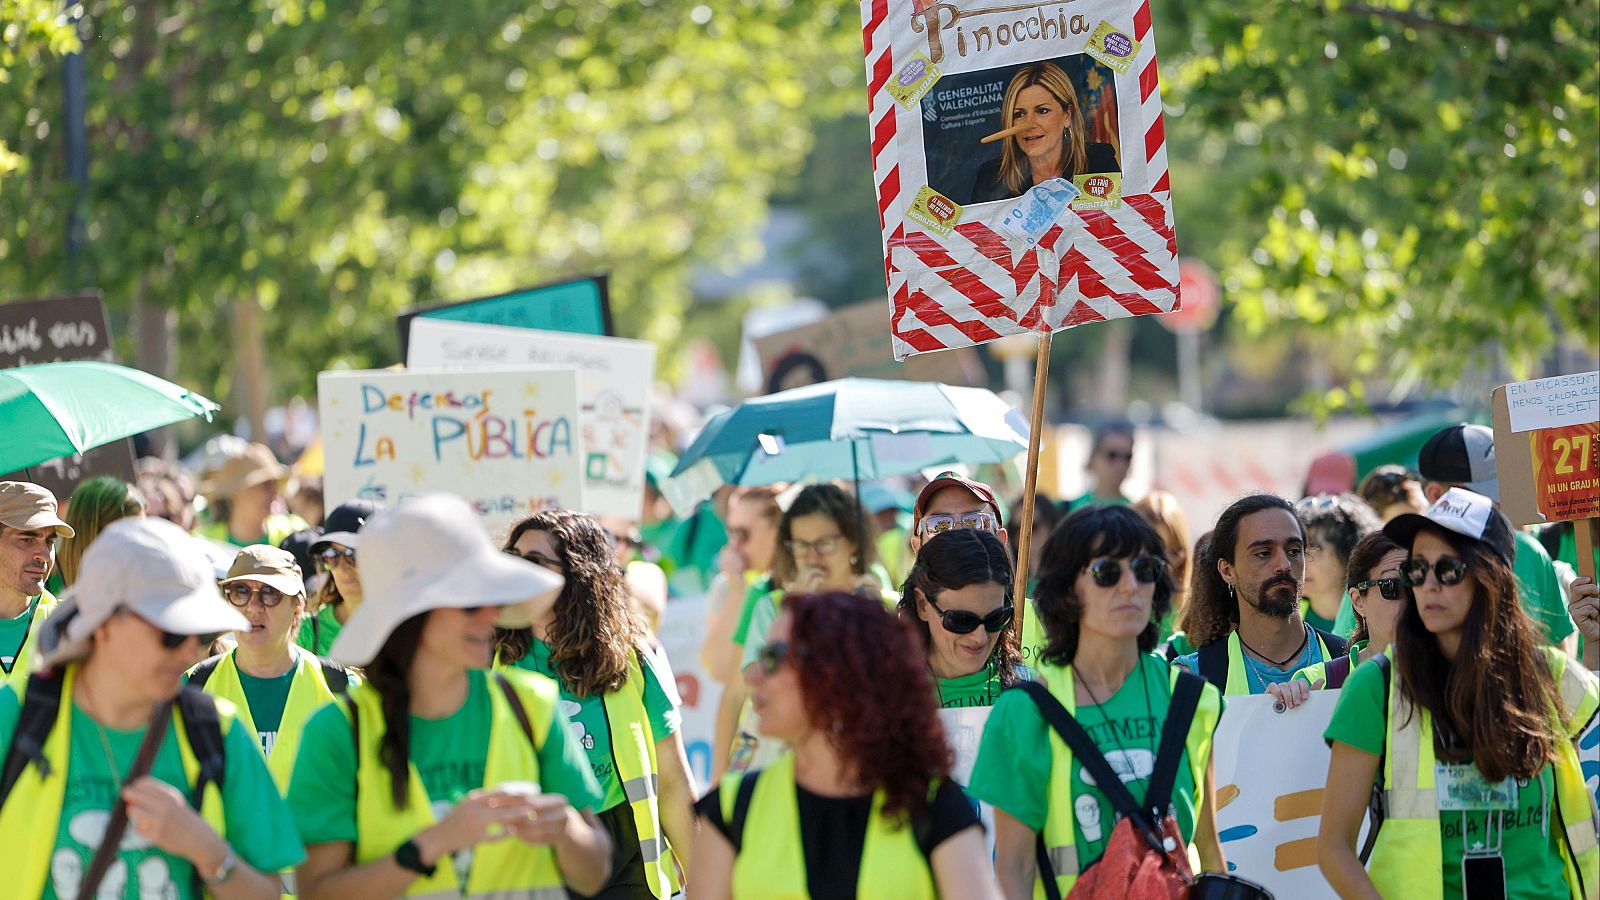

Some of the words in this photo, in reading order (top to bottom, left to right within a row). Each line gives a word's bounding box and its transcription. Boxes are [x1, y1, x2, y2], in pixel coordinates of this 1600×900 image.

[911, 3, 1090, 64] Pinocchia
[937, 81, 1004, 101] GENERALITAT
[939, 93, 1003, 111] VALENCIANA
[1510, 384, 1527, 395] EN
[1535, 374, 1597, 391] PICASSENT
[1512, 396, 1543, 409] MENOS
[1547, 390, 1579, 402] CALOR
[1580, 386, 1599, 396] QUE
[1545, 399, 1598, 416] PESET
[1552, 434, 1590, 475] 27
[1547, 483, 1556, 494] NI
[1557, 481, 1568, 492] UN
[1570, 479, 1591, 491] GRAU
